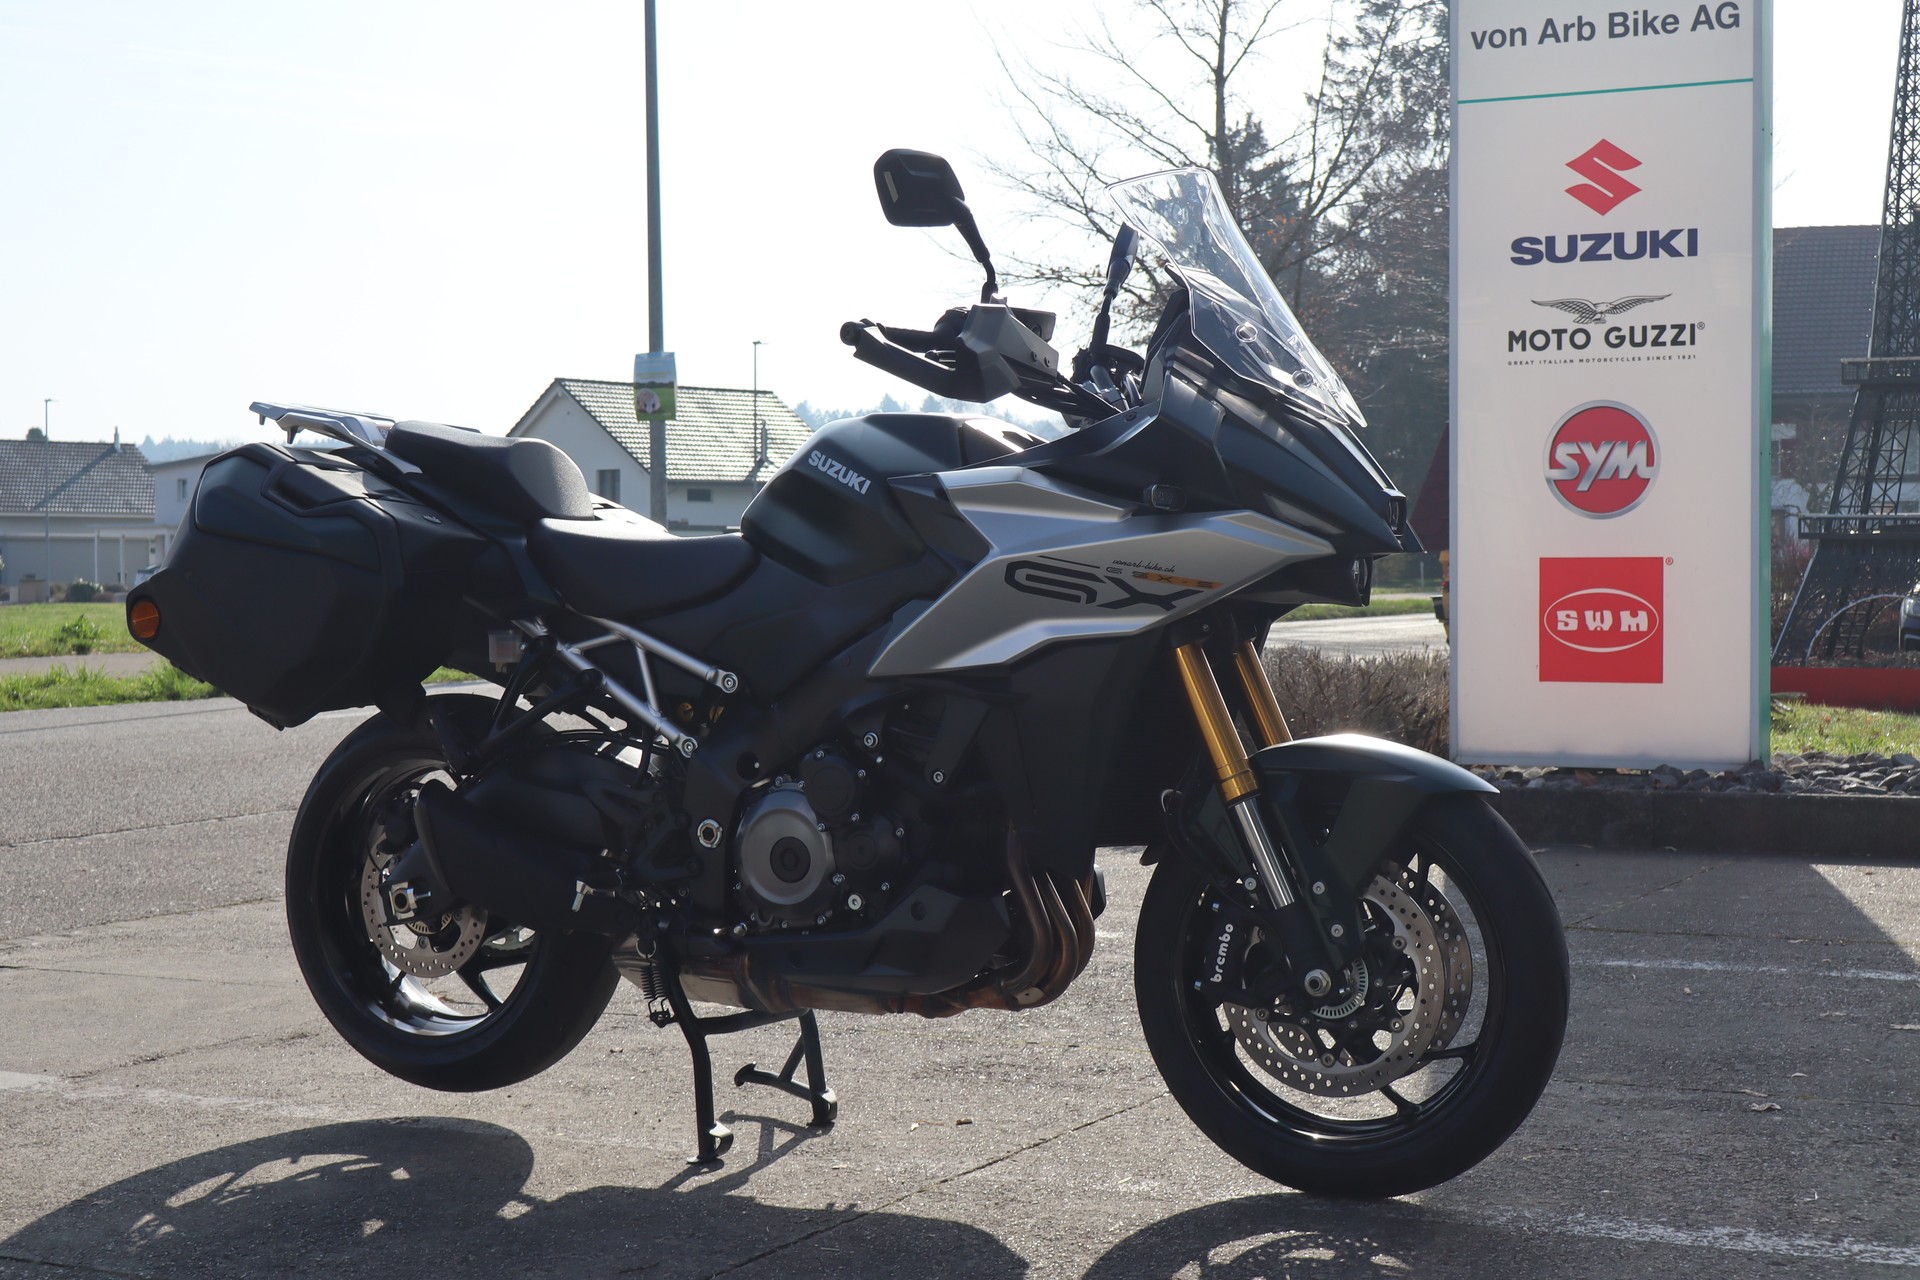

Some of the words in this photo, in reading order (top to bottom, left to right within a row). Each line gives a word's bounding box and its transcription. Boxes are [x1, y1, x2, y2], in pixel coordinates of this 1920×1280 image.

[1470, 26, 1527, 50] von
[1538, 15, 1596, 45] Arb
[1608, 9, 1680, 39] Bike
[1690, 1, 1741, 32] AG
[1510, 228, 1698, 266] SUZUKI
[1508, 328, 1591, 352] MOTO
[808, 450, 871, 495] SUZUKI
[1549, 440, 1655, 492] SYM
[1112, 560, 1176, 573] vonarb-bike.ch
[1556, 610, 1649, 632] SWM
[1210, 923, 1234, 983] brembo
